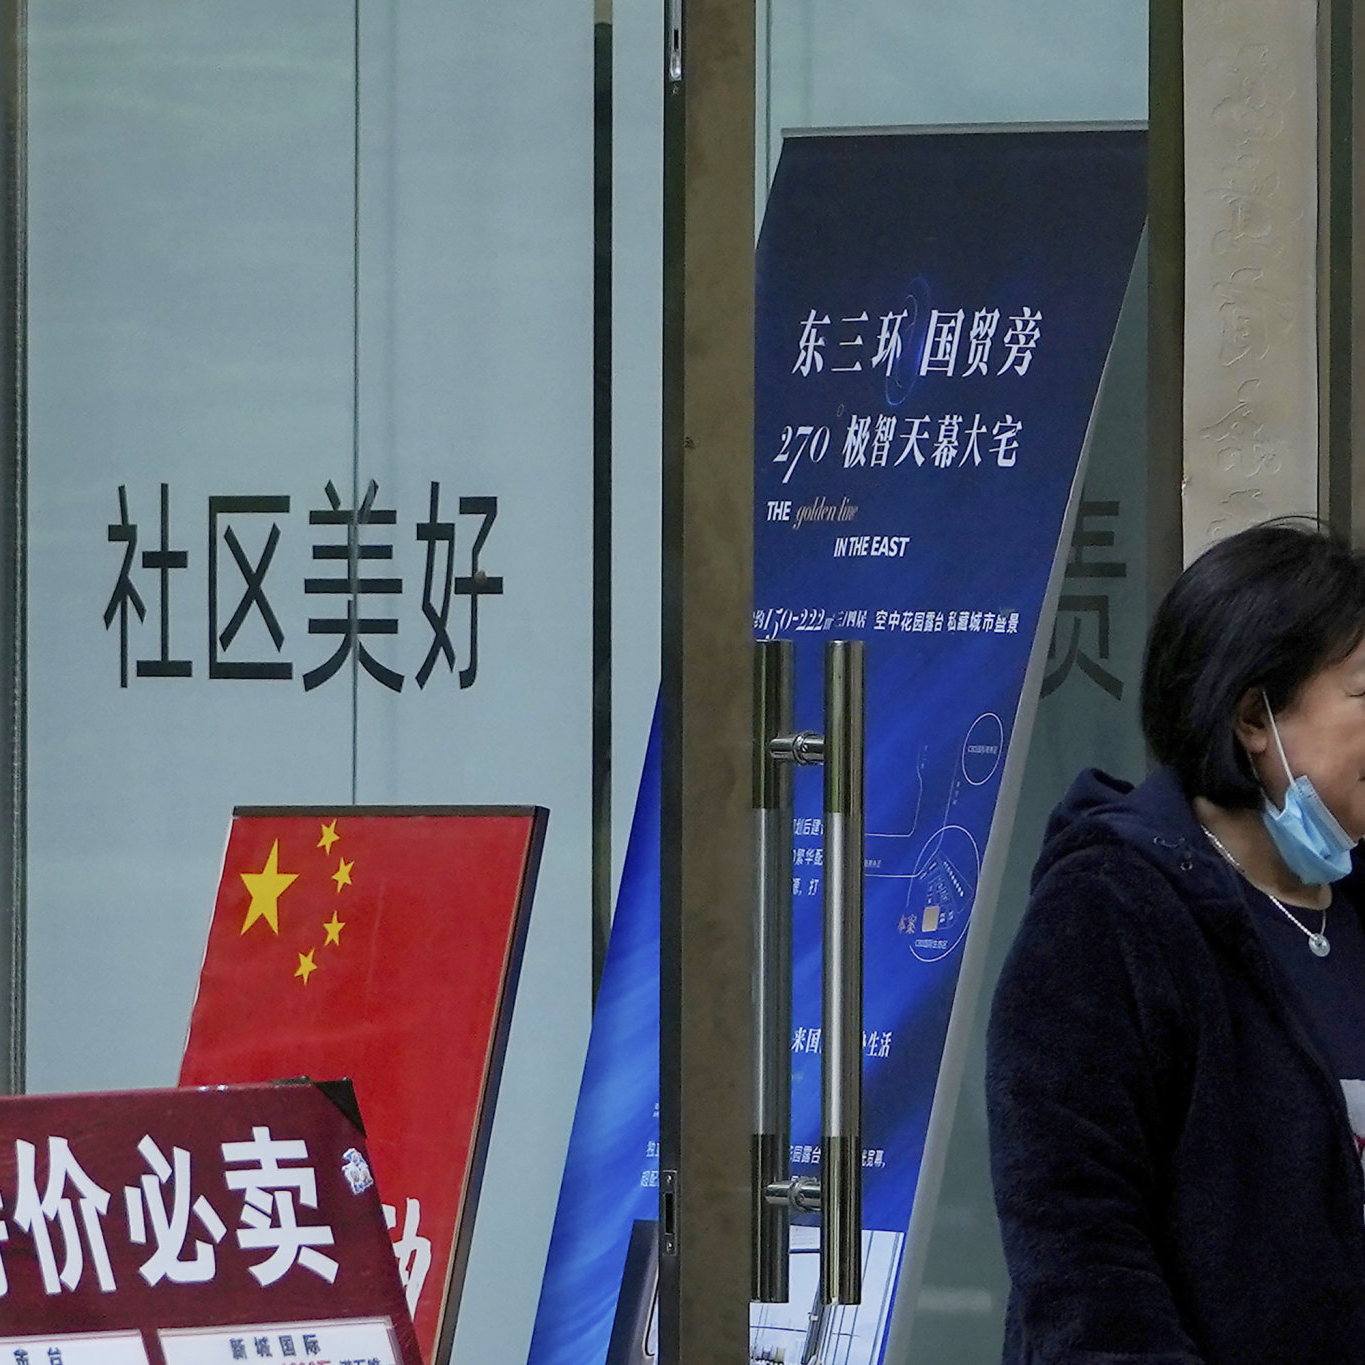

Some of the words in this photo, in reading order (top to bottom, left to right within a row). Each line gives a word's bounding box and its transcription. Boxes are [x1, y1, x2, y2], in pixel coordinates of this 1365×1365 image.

[790, 308, 909, 377] 东三环
[919, 306, 1043, 377] 国贸旁
[773, 425, 832, 484] 270
[842, 413, 1023, 468] 极智天幕大宅
[767, 500, 792, 521] THE
[834, 538, 847, 557] IN
[848, 538, 870, 556] THE
[870, 537, 910, 557] EAST
[103, 478, 503, 693] 社区美好
[873, 610, 944, 632] 空中花园露台
[229, 1334, 321, 1361] 新城国际
